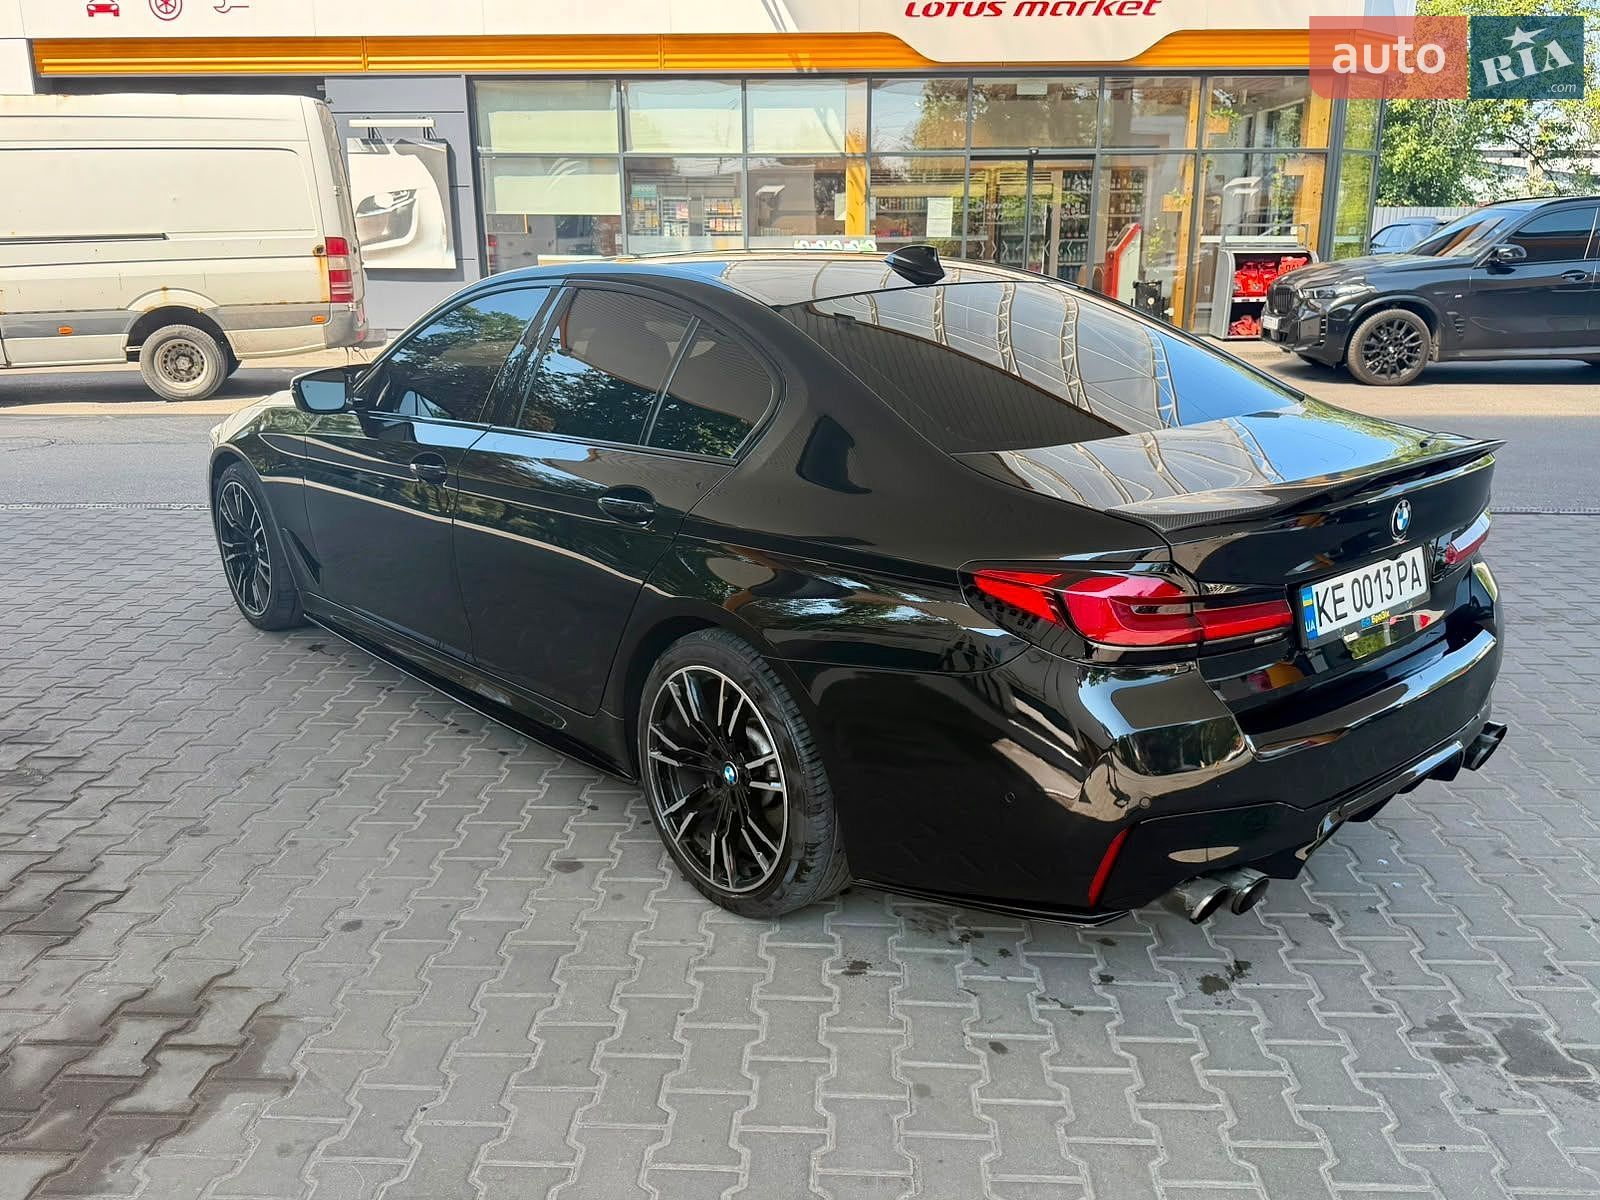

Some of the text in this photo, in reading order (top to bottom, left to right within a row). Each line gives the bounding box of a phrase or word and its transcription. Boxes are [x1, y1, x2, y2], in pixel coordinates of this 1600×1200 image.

[905, 0, 1163, 18] LOTUS market
[1315, 582, 1348, 627] KE
[1351, 565, 1394, 613] 0013
[1396, 556, 1422, 596] PA
[1304, 620, 1316, 633] UA
